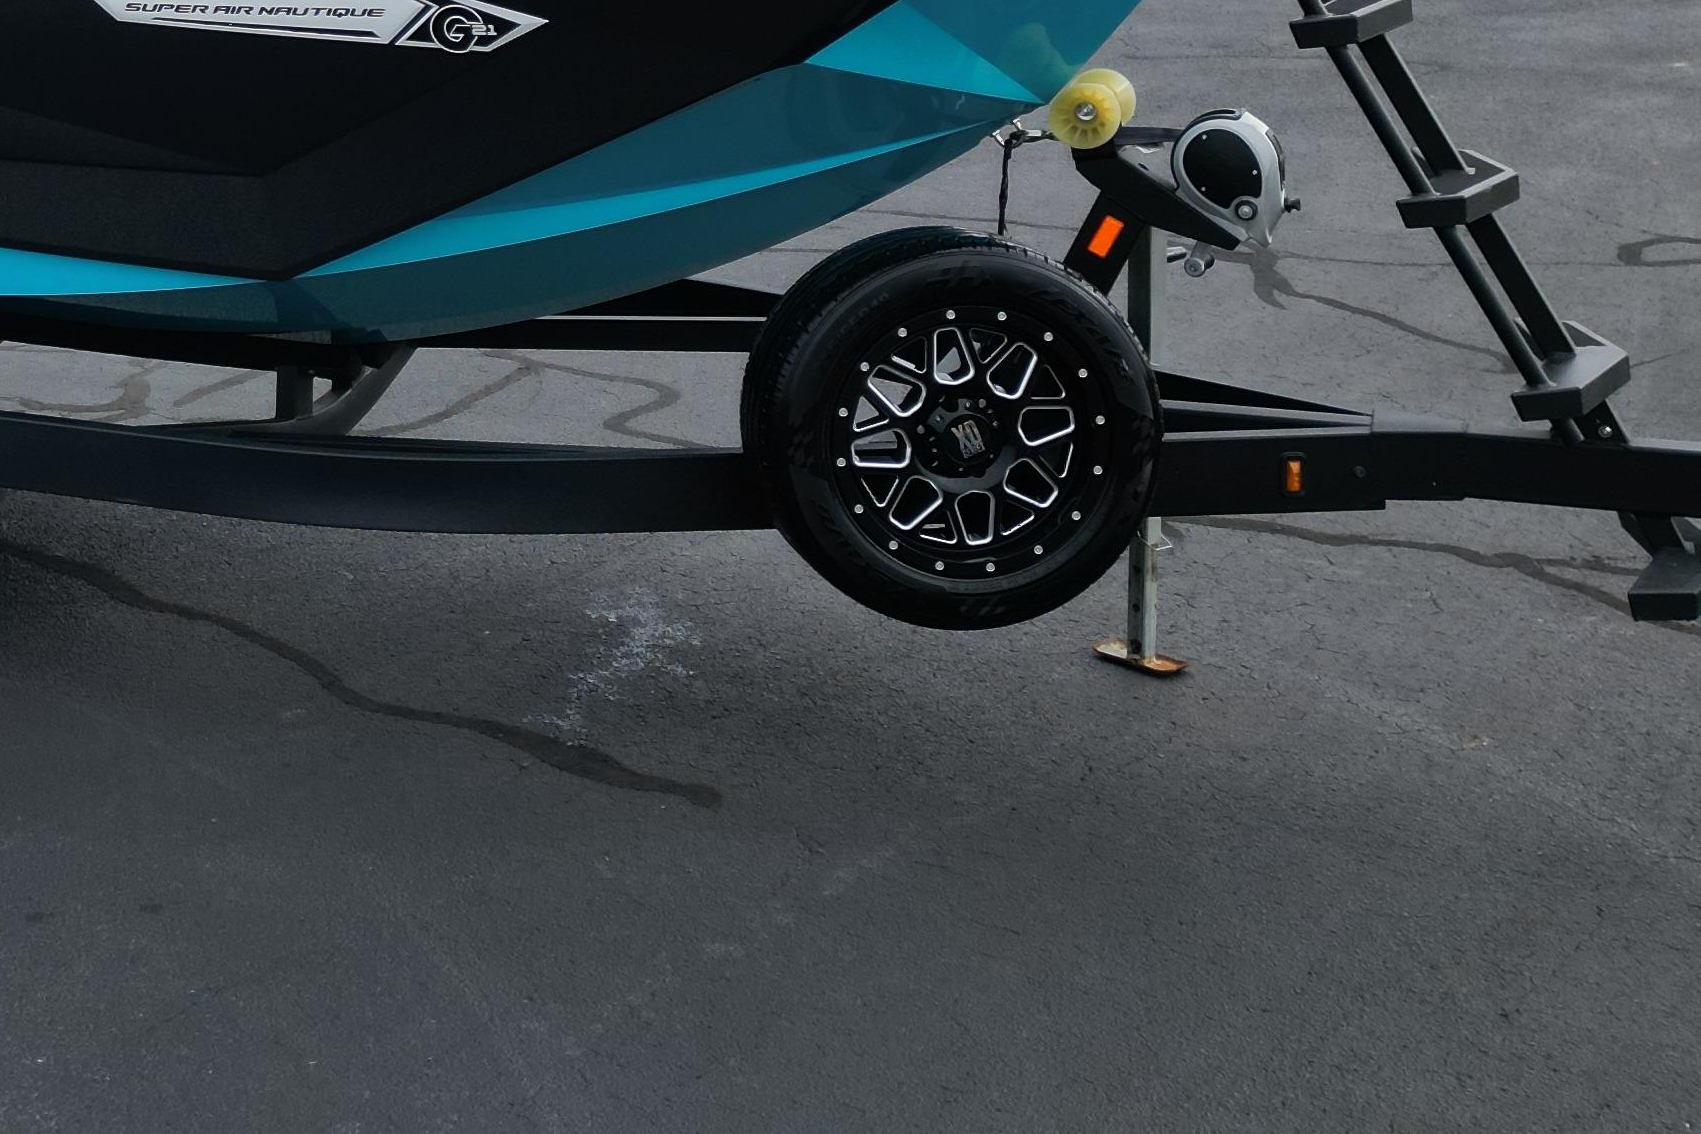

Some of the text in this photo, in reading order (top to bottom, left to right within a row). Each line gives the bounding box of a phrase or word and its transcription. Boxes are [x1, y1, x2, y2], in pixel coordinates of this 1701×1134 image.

[124, 2, 387, 19] SUPER AIR NAUTIQUE
